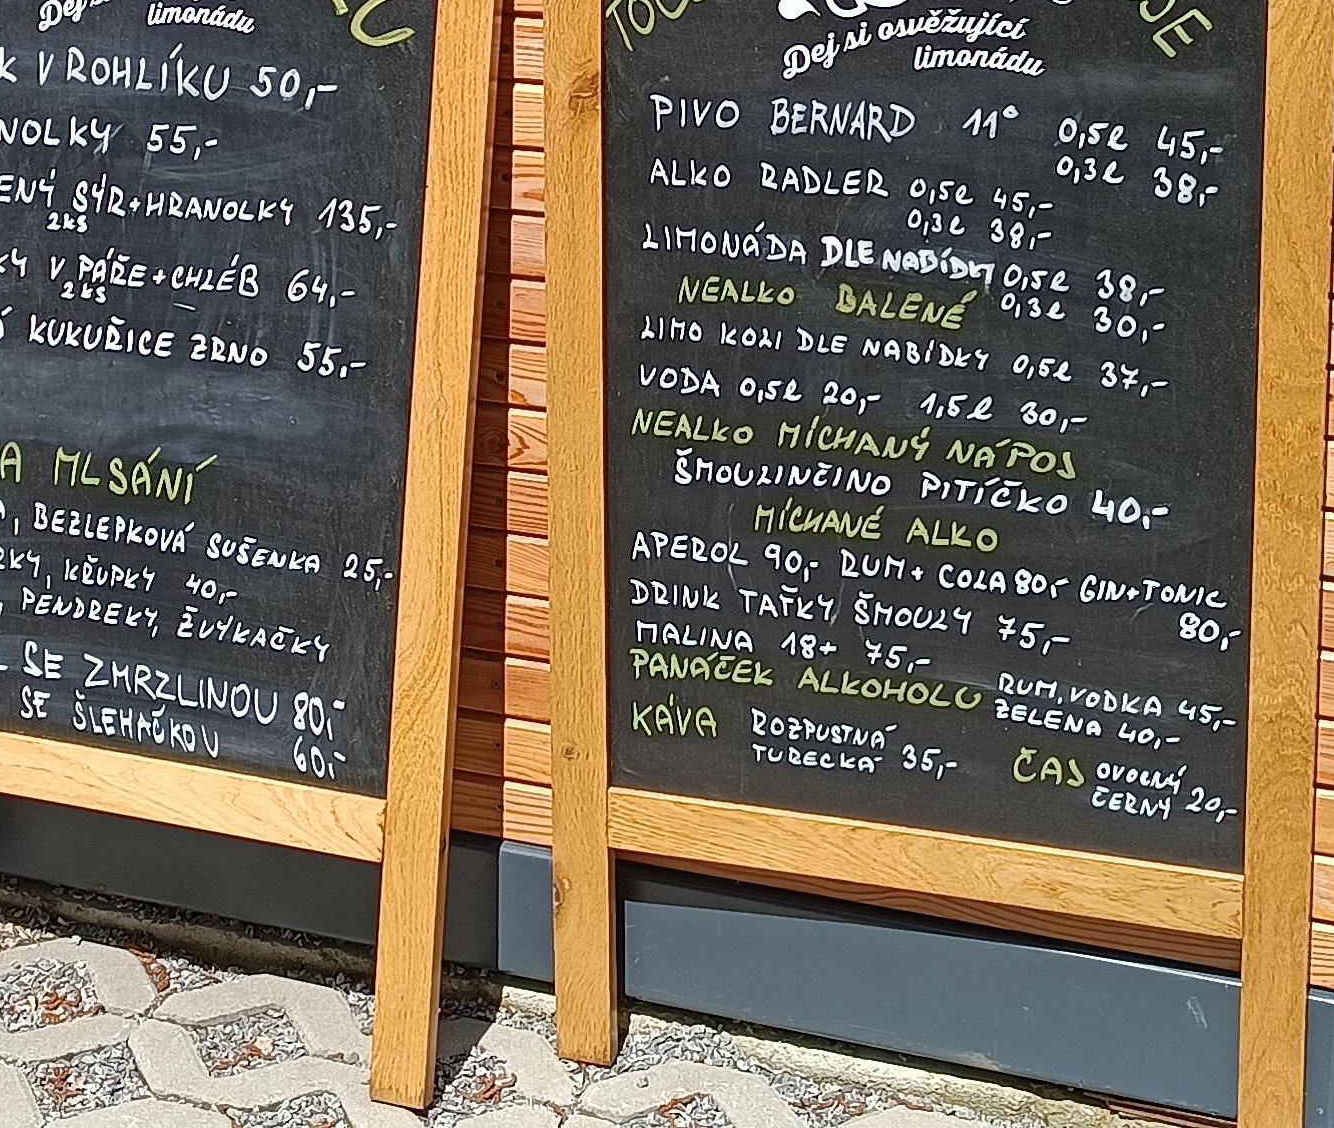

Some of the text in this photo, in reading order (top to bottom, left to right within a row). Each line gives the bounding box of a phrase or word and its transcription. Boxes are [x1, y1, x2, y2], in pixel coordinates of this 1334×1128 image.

[146, 1, 256, 34] limonádu
[782, 8, 1031, 80] Dej si osvěžující
[37, 50, 55, 88] V
[66, 44, 233, 101] ROHLÍKU
[250, 66, 338, 110] 50,-
[913, 44, 1047, 76] limonádu
[146, 124, 219, 160] 55,-
[649, 93, 741, 132] PIVO
[769, 97, 917, 144] BERNARD
[1156, 124, 1224, 165] 45,-
[649, 157, 733, 188] ALKO
[760, 161, 889, 197] RADLER
[993, 187, 1054, 219] 45,-
[1153, 166, 1219, 207] 38,-
[989, 217, 1052, 250] 38,-
[49, 255, 66, 283] V
[286, 269, 357, 309] 64,-
[642, 221, 807, 265] LIMONÁDA
[820, 234, 875, 268] DLE
[1096, 269, 1165, 307] 38,-
[678, 275, 978, 330] NEALKO BALENÉ
[1093, 306, 1166, 344] 30,-
[28, 315, 174, 359] KUKUŘICE
[189, 333, 269, 368] ZRNO
[296, 341, 367, 380] 55,-
[640, 315, 703, 342] LIMO
[720, 321, 783, 351] KOLI
[796, 326, 848, 354] DLE
[861, 339, 990, 371] NABÍDKY
[638, 363, 721, 398] VODA
[822, 381, 881, 416] 20,-
[1020, 401, 1088, 433] 30,-
[631, 408, 1077, 480] NEALKO MÍCHANÝ NÁPOJ
[53, 447, 219, 505] MLSÁNÍ
[673, 447, 1170, 530] ŠMOULINČINO PITÍČKO 40,-
[32, 502, 196, 555] BEZLEPKOVÁ
[205, 532, 322, 576] SUŠENKA
[343, 552, 394, 592] 25,-
[631, 531, 749, 566] APEROL
[763, 543, 819, 583] 90,-
[906, 516, 999, 553] ALKO
[64, 554, 156, 593] KŘUPKY
[184, 574, 239, 605] 40,-
[630, 578, 720, 610] DRINK
[853, 591, 972, 635] ŠMOULY
[636, 620, 754, 652] MALINA
[780, 631, 838, 659] 18+
[1178, 612, 1242, 651] 80,-
[22, 641, 65, 680] SE
[83, 652, 280, 726] ZMRZLINOU
[293, 691, 346, 740] 80,-
[629, 648, 774, 687] PANÁČEK
[797, 667, 982, 710] ALKOHOLU
[1070, 686, 1163, 717] VODKA
[1177, 699, 1237, 732] 45,-
[19, 683, 51, 720] SE
[293, 739, 347, 780] 60,-
[633, 693, 718, 738] KÁVA
[750, 707, 898, 750] ROZPUSTNÁ
[1012, 746, 1085, 788] ČAJ
[1117, 722, 1181, 750] 40,-
[751, 743, 884, 775] TURECKÁ
[901, 744, 958, 780] 35,-
[1184, 787, 1238, 823] 20,-
